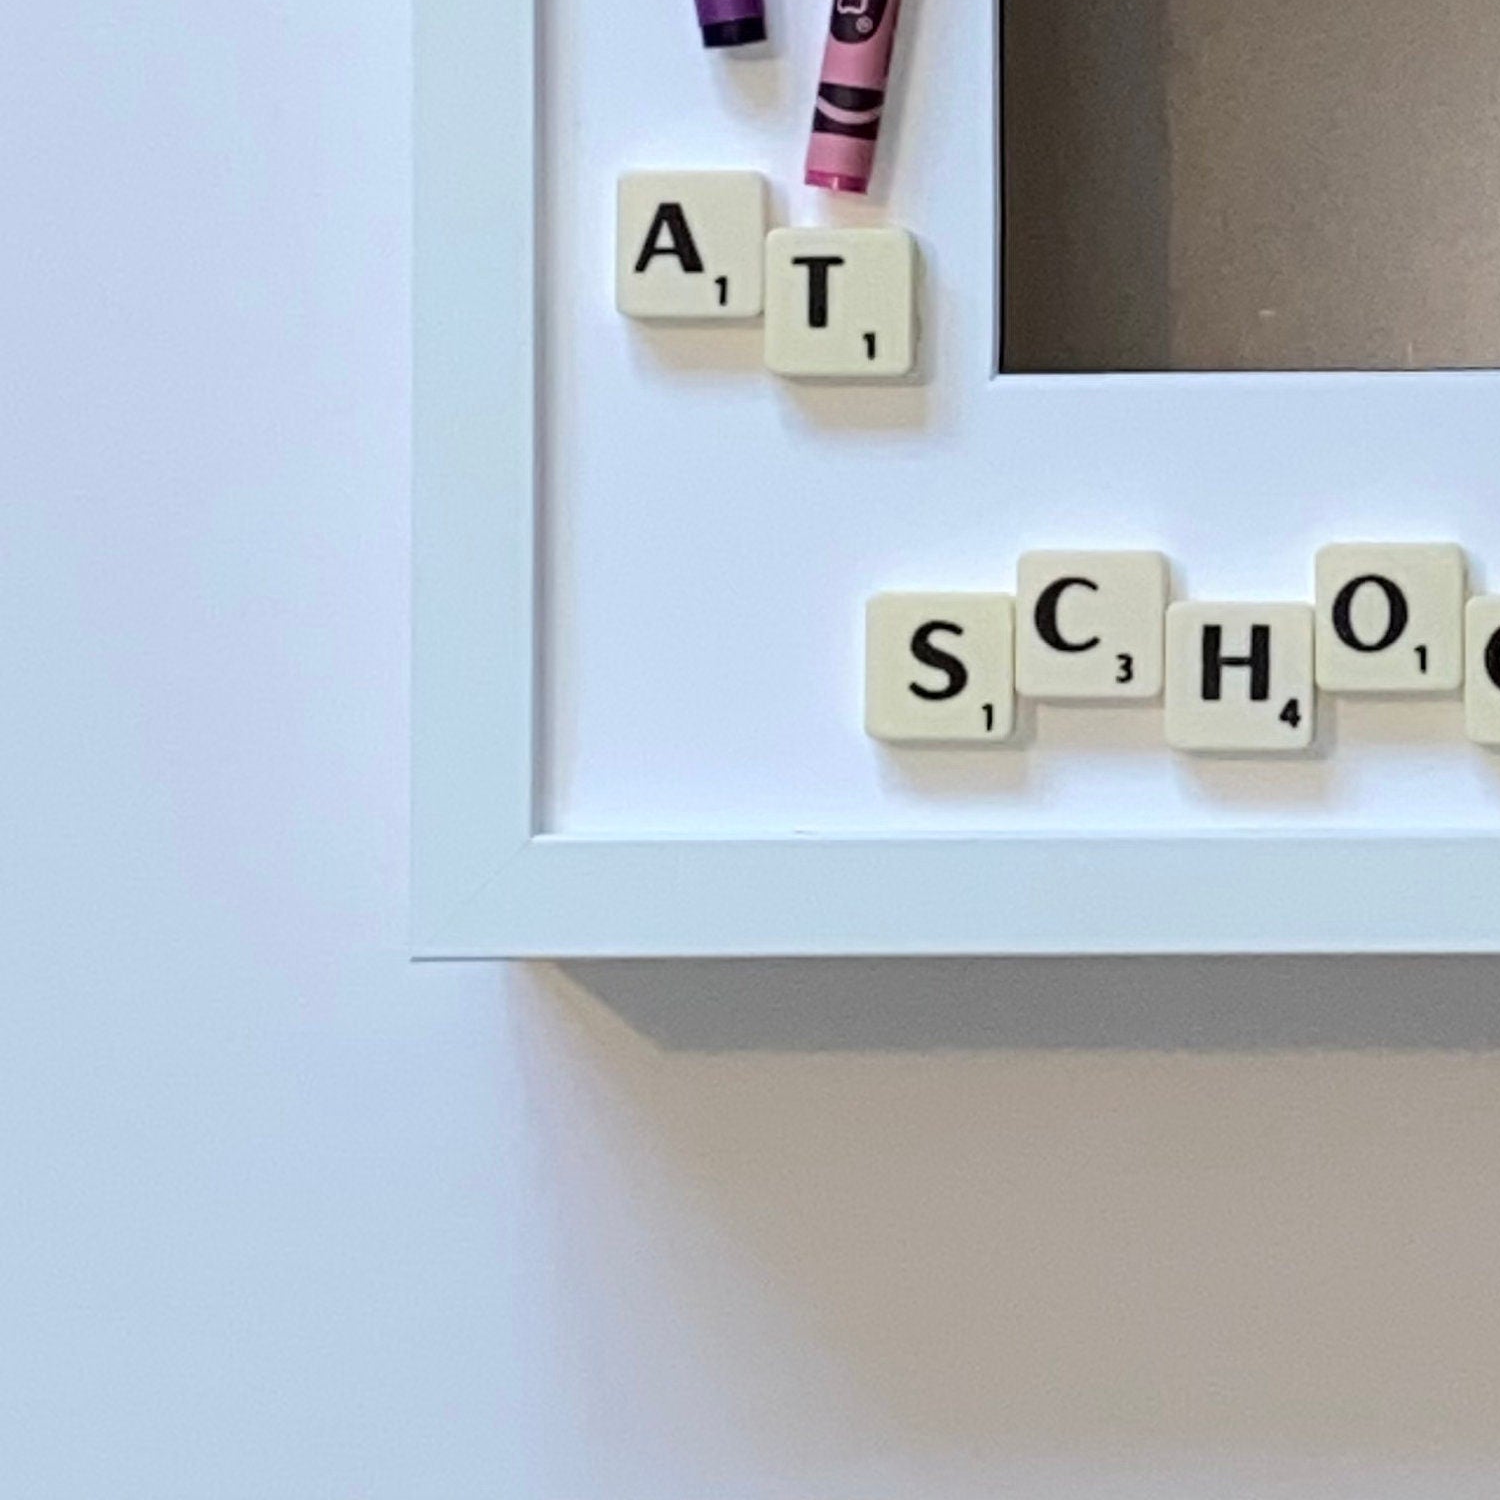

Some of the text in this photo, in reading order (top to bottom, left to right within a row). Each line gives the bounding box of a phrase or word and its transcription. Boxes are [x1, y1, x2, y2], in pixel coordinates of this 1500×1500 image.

[634, 202, 845, 329] AT
[714, 275, 877, 361] 1 1
[980, 702, 995, 733] 1
[1115, 653, 1135, 684] 3
[1278, 698, 1302, 729] 4
[1413, 644, 1428, 674] 1
